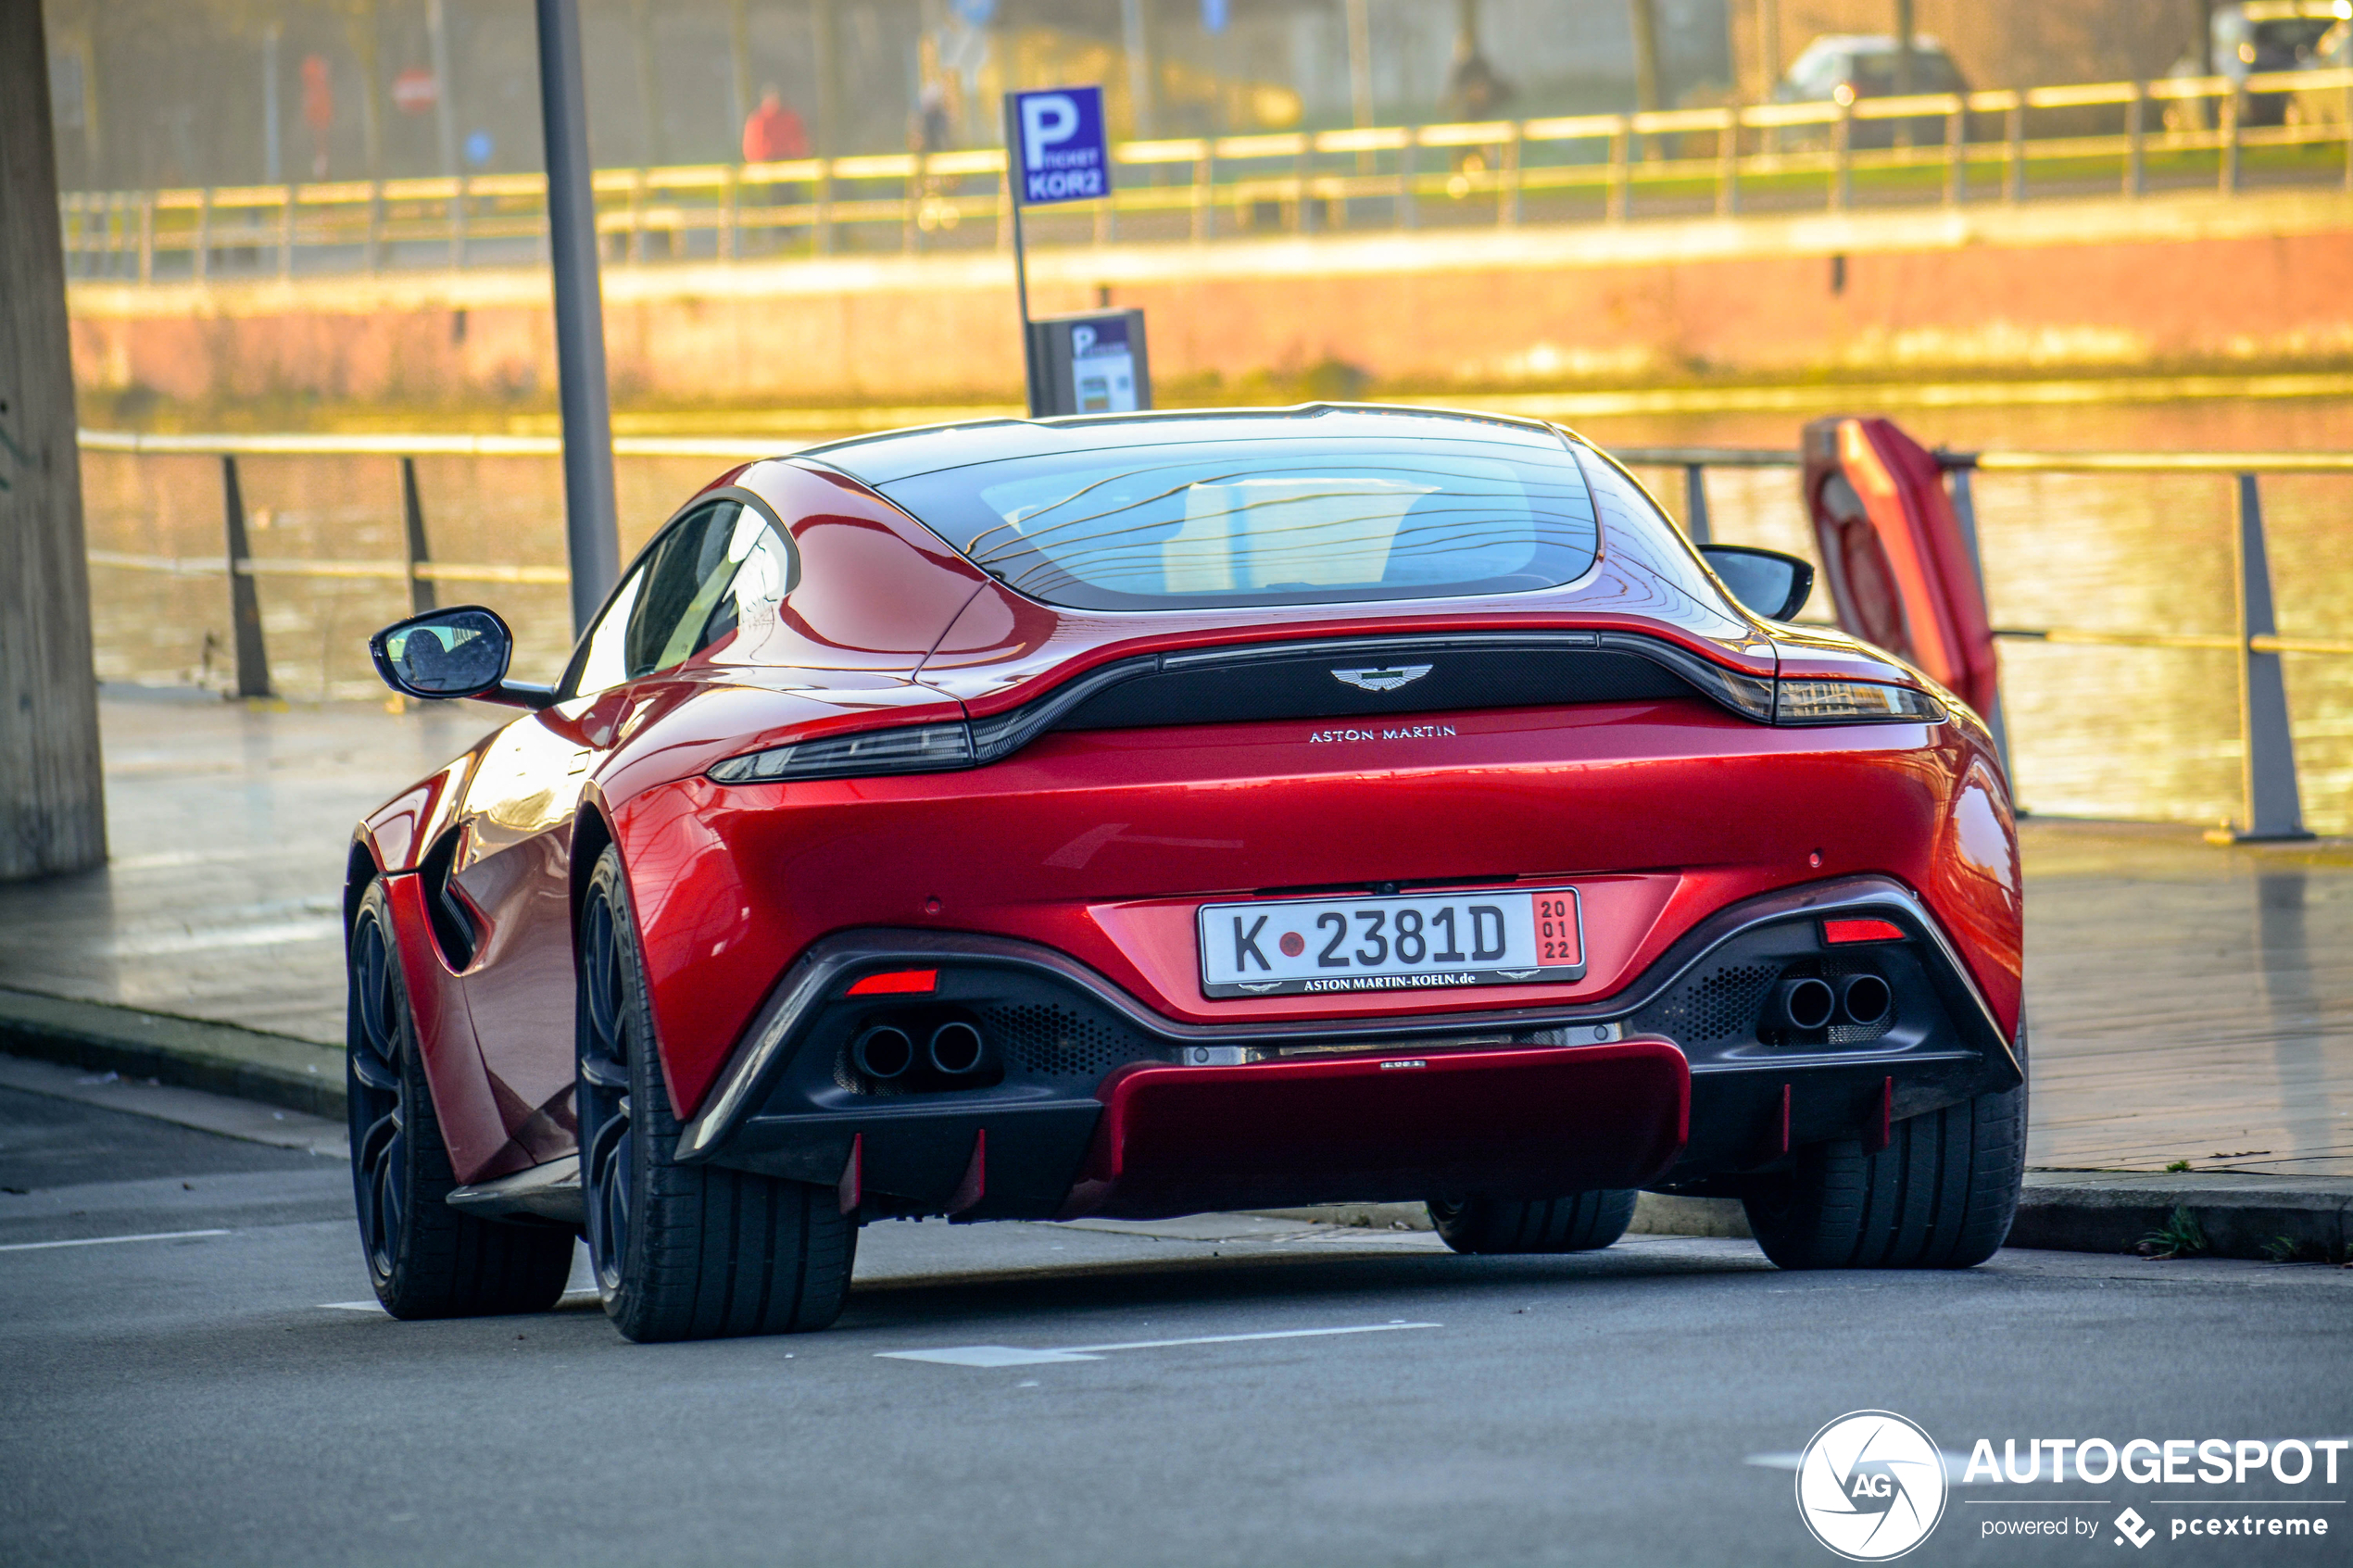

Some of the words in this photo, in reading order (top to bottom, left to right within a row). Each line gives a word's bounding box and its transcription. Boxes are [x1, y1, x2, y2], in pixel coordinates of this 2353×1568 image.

[1022, 95, 1080, 170] P
[1027, 168, 1102, 200] KOR2
[1072, 325, 1097, 358] P
[1309, 729, 1375, 744] ASTON
[1382, 725, 1456, 740] MARTIN
[1541, 900, 1566, 918] 20
[1233, 915, 1271, 972] K
[1317, 905, 1506, 968] 2381D
[1543, 921, 1566, 938] 01
[1544, 941, 1569, 959] 22
[1303, 979, 1350, 992] ASTON
[1353, 972, 1476, 990] MARTIN-KOELN.de
